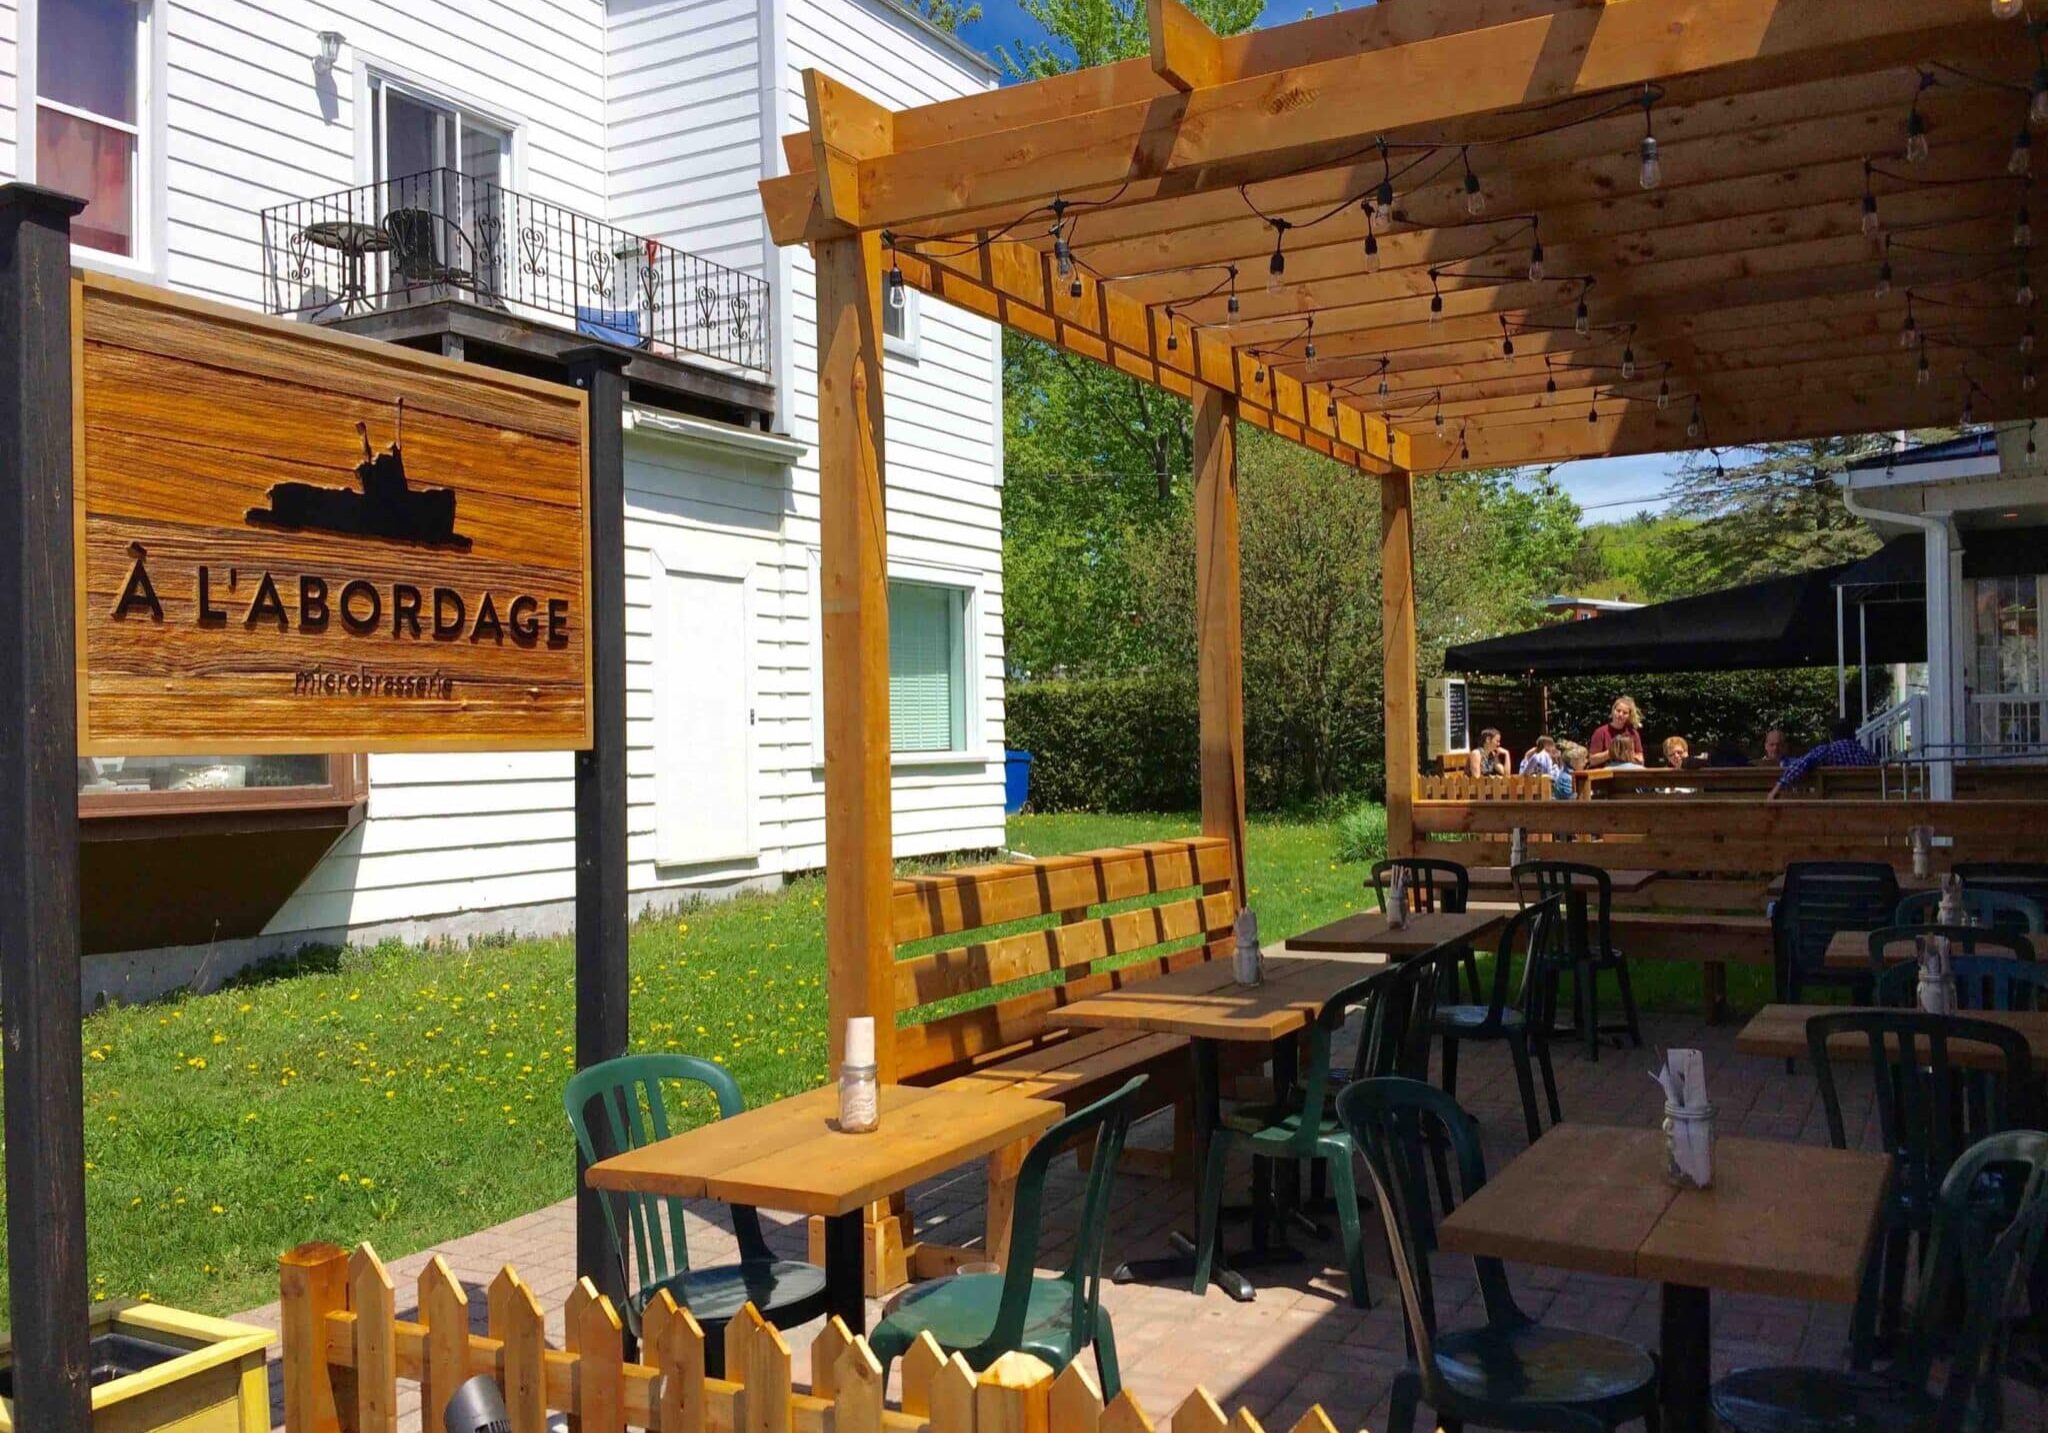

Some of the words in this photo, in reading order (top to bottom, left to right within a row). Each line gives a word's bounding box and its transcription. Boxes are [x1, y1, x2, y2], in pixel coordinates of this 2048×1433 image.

[111, 540, 164, 622] À
[198, 564, 569, 648] L'ABORDAGE
[295, 664, 453, 698] microbrasserie
